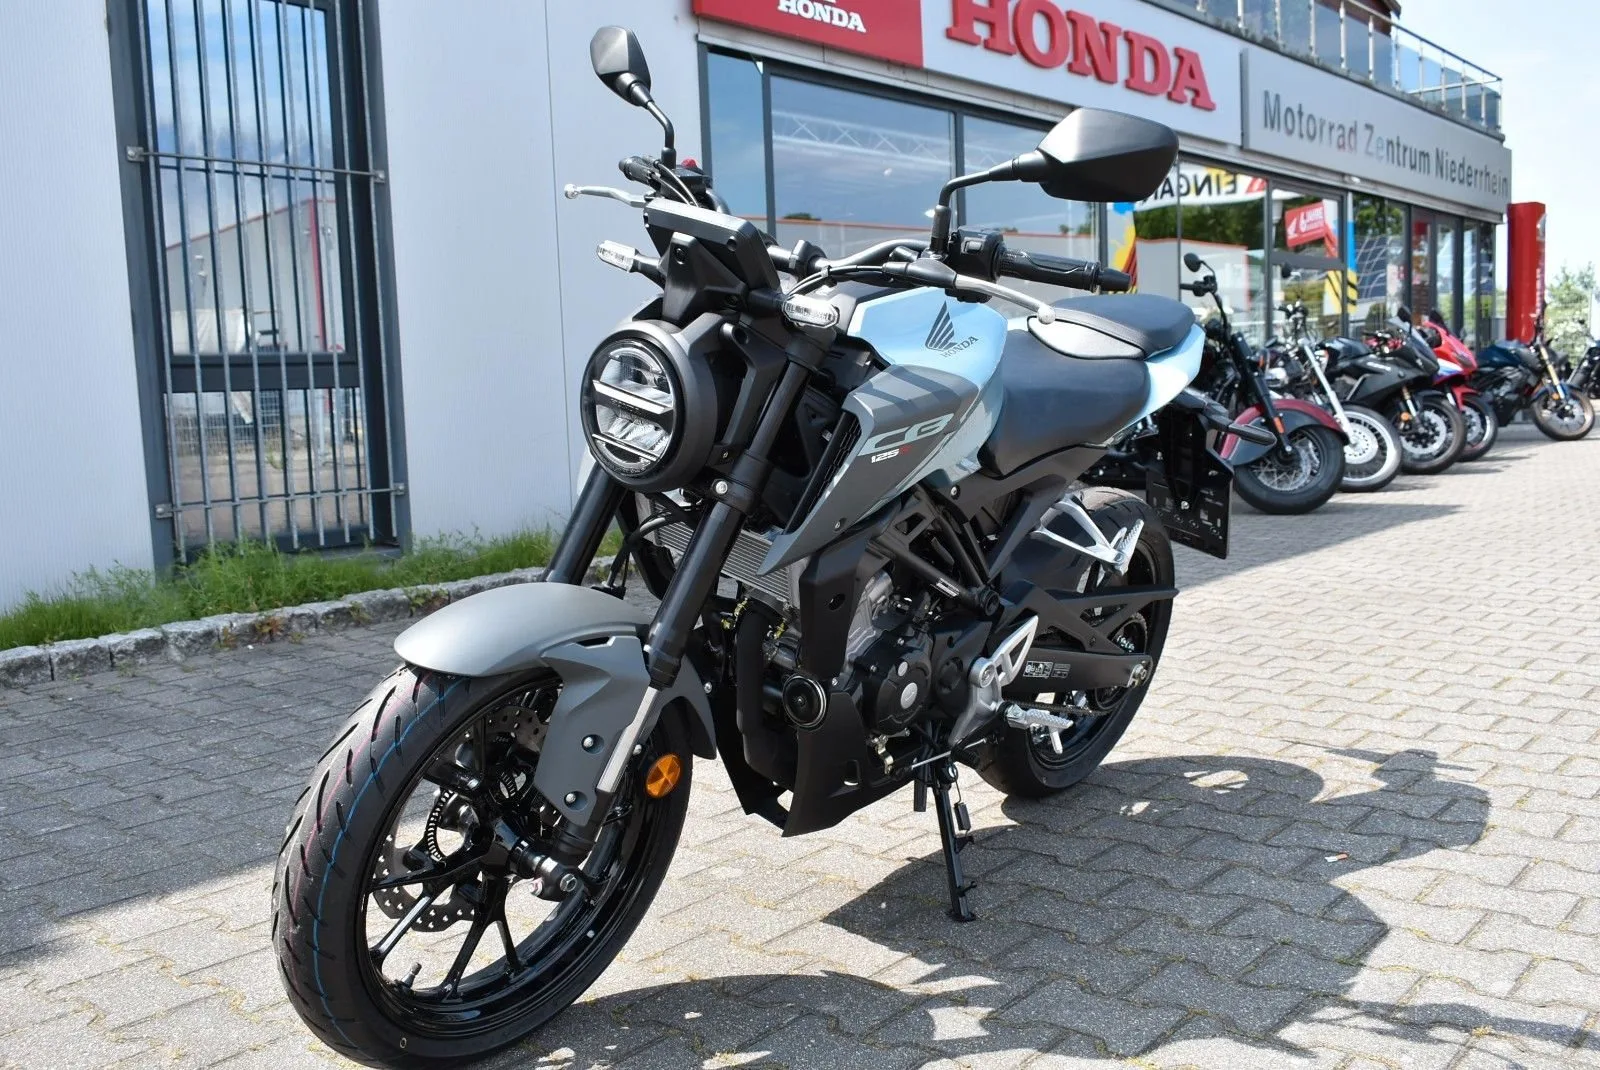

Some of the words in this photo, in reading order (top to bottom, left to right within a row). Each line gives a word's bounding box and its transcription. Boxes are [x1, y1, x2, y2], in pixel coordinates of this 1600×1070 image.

[778, 0, 866, 33] HONDA
[946, 0, 1216, 110] HONDA
[1263, 90, 1358, 152] Motorrad
[1364, 123, 1431, 175] Zentrum
[1435, 147, 1508, 197] Niederrhein
[940, 335, 979, 358] HONDA
[857, 413, 954, 457] CB
